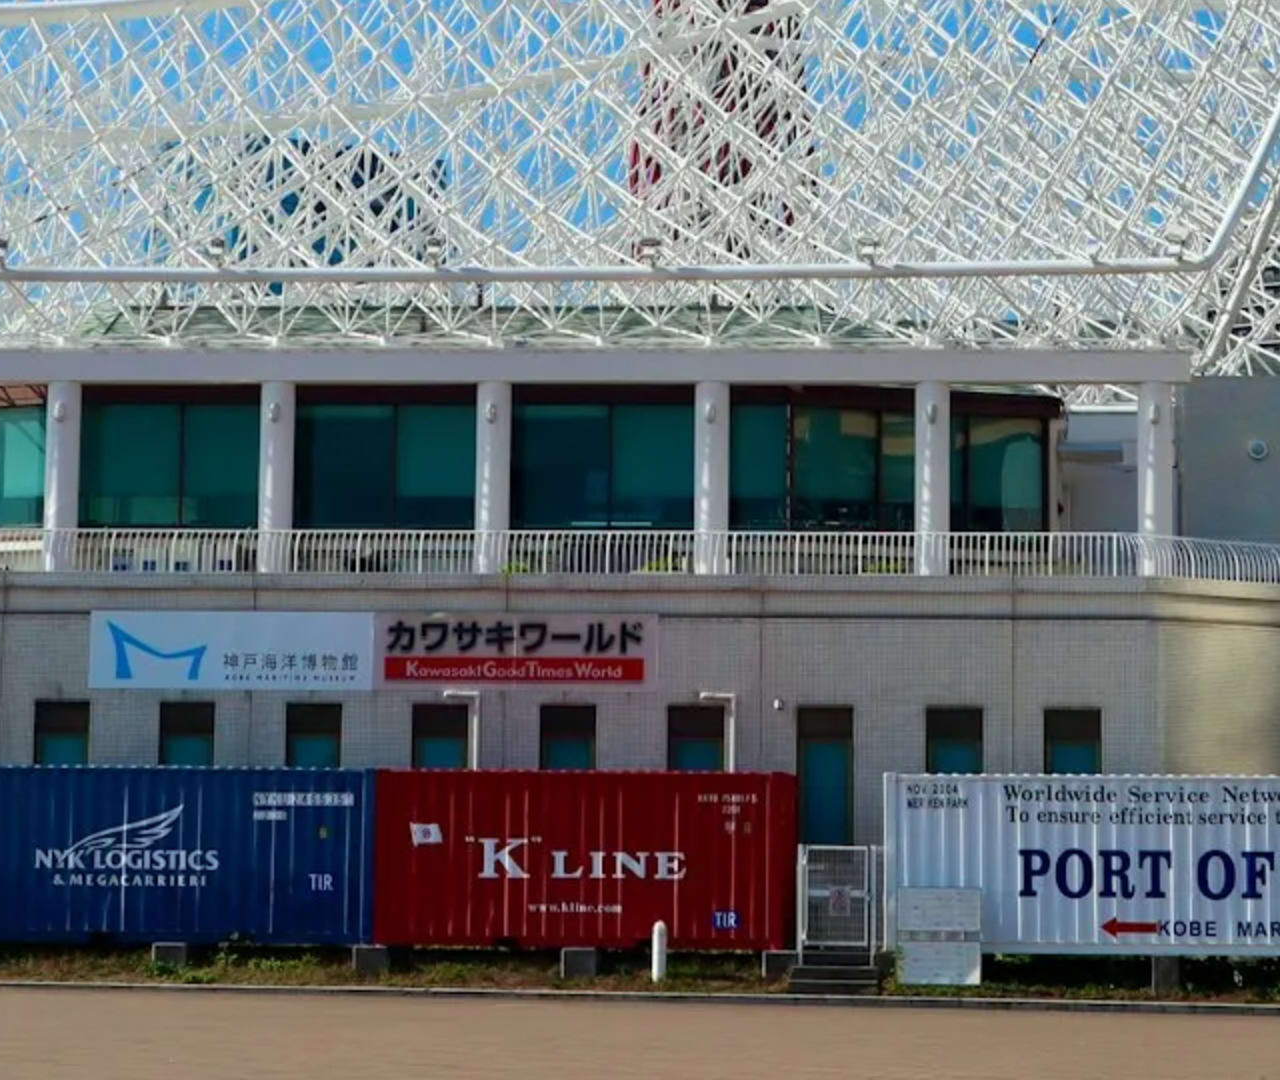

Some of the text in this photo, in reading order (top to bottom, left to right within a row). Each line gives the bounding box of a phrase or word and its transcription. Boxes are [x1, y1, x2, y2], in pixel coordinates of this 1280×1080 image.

[386, 619, 643, 653] カワサキワールド
[223, 652, 359, 671] 神戸海洋博物館
[405, 660, 623, 679] Kawasaki Good Times World
[1003, 783, 1118, 804] Worldwide
[1128, 786, 1211, 804] Service
[1005, 806, 1031, 824] To
[1036, 811, 1101, 825] ensure
[1109, 806, 1193, 825] efficient
[1198, 808, 1267, 825] service
[34, 849, 220, 871] NYK LOGISTICS
[551, 850, 687, 880] LINE
[53, 874, 66, 886] &
[308, 873, 334, 892] TIR
[1019, 849, 1172, 899] PORT
[1197, 849, 1276, 900] OF
[528, 901, 623, 914] www.kline.com
[714, 911, 738, 930] TIR
[1157, 920, 1217, 938] KOBE
